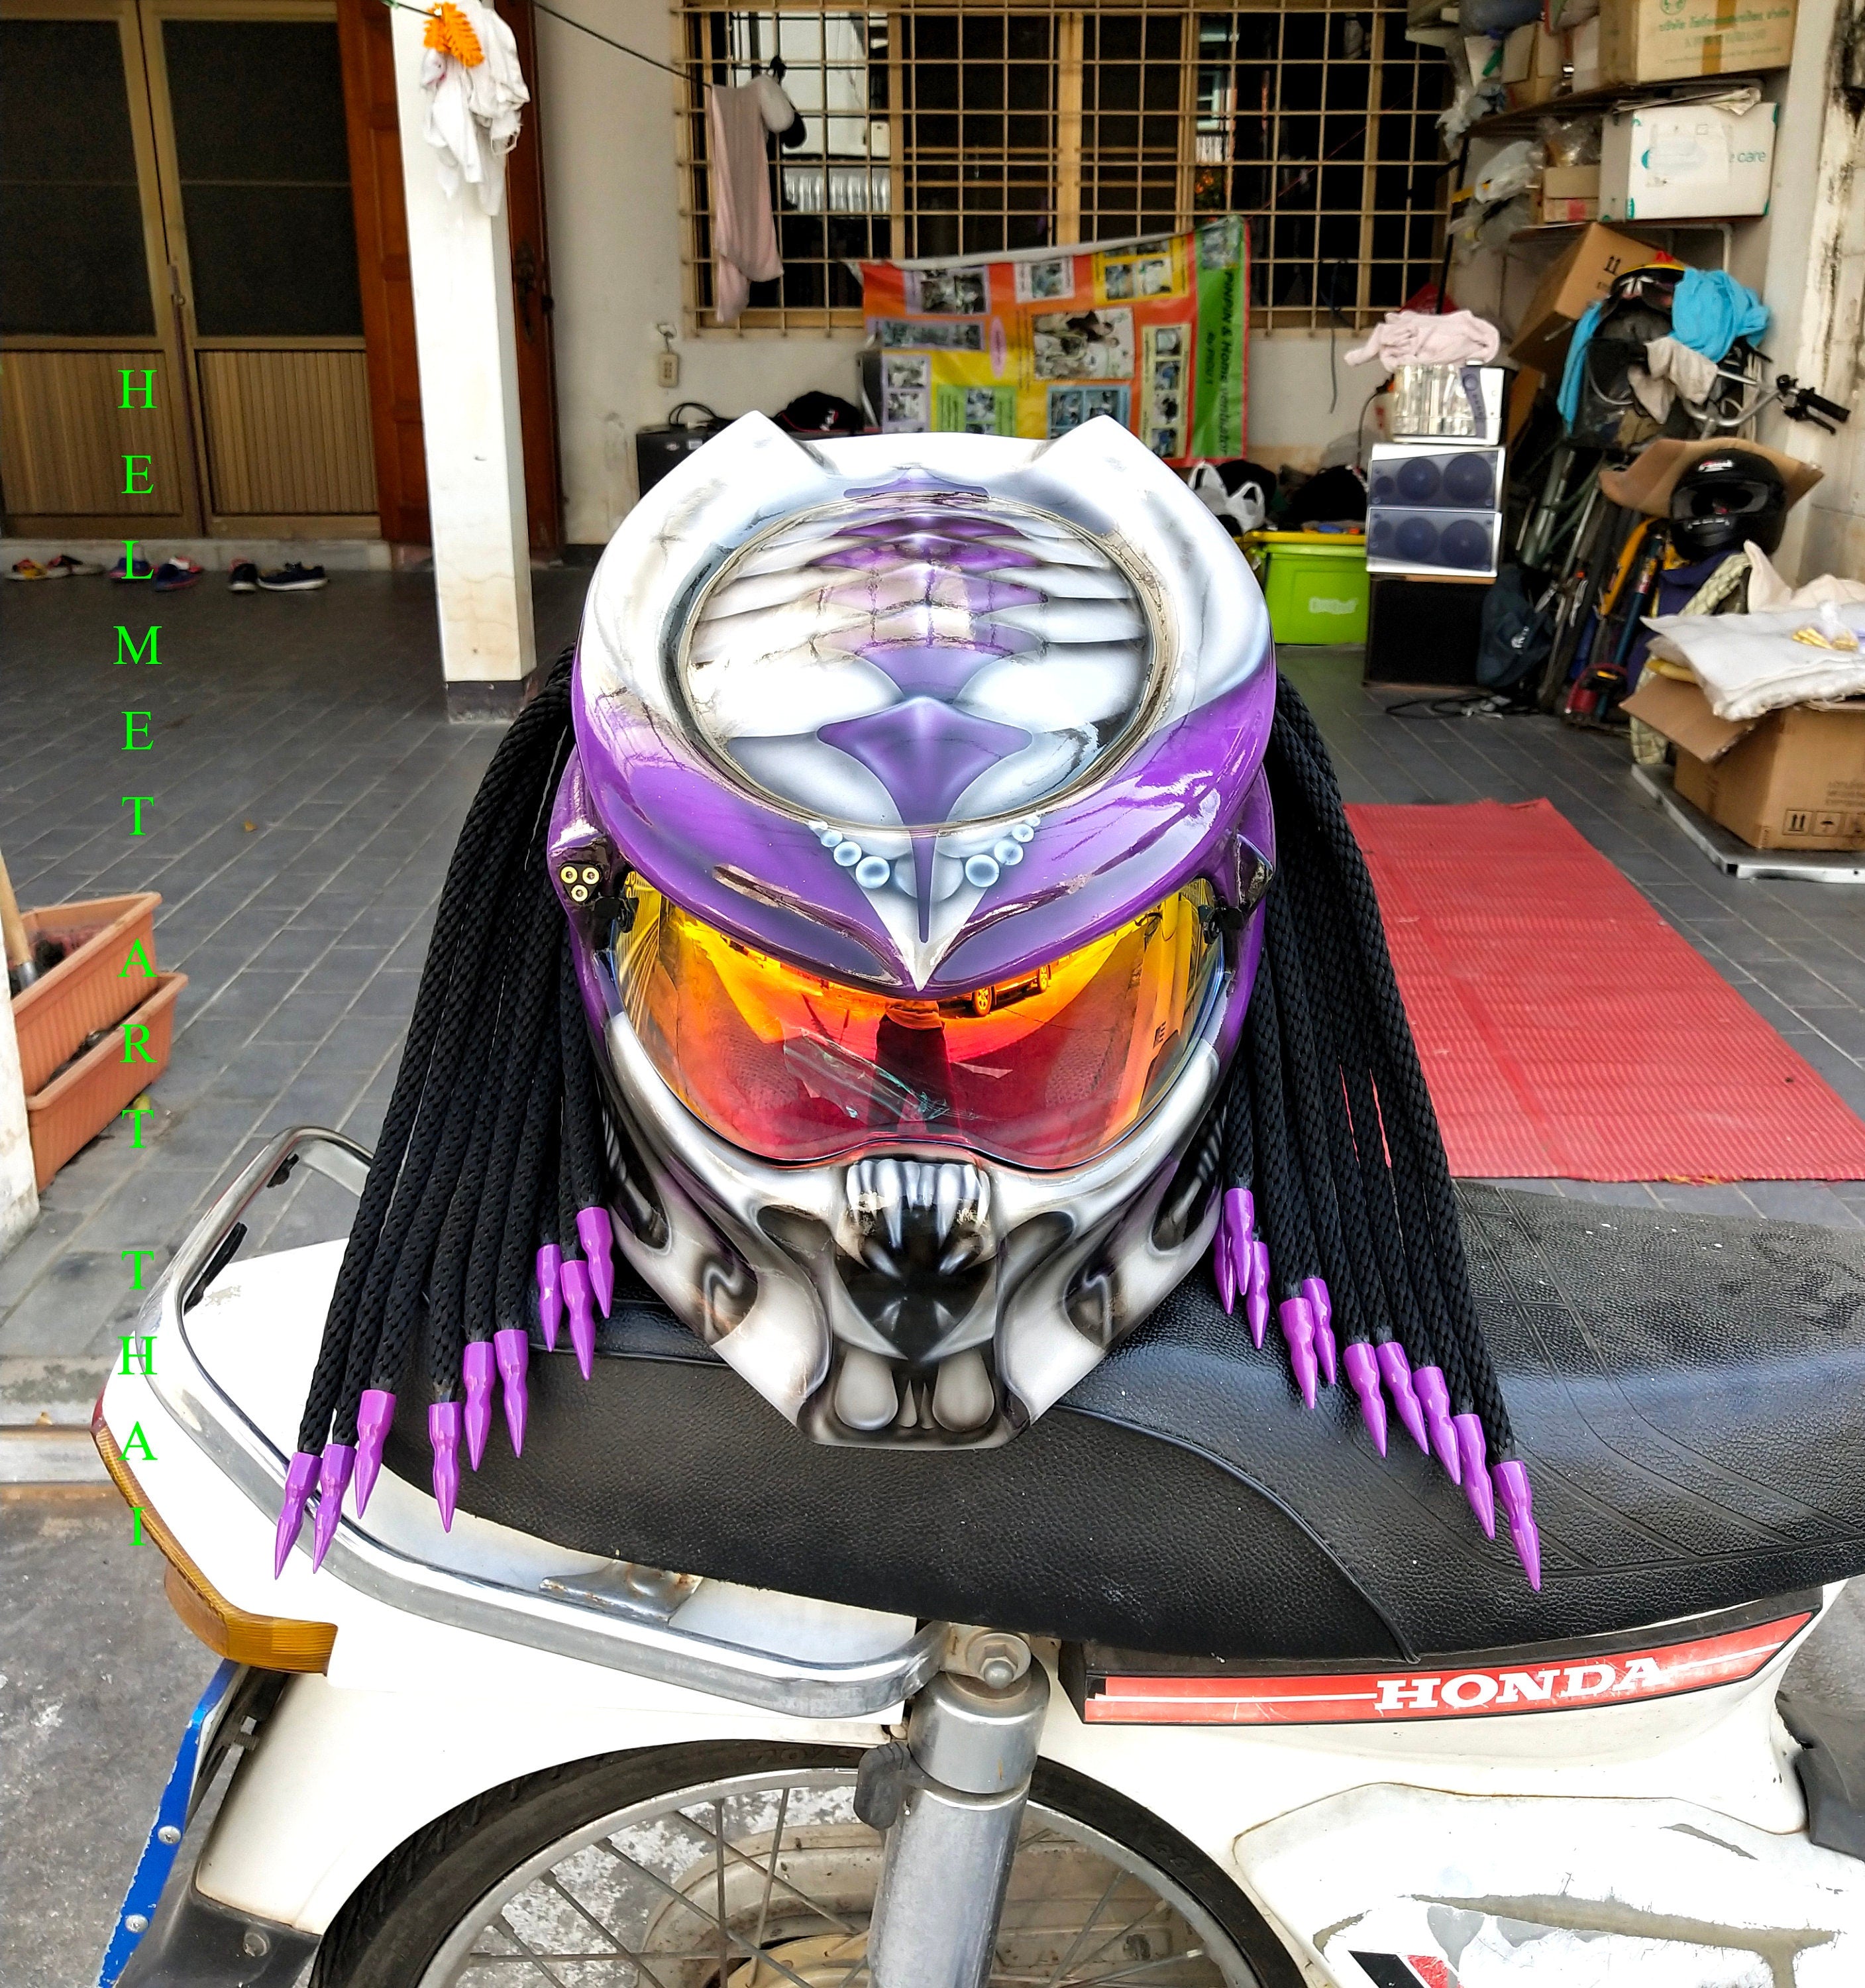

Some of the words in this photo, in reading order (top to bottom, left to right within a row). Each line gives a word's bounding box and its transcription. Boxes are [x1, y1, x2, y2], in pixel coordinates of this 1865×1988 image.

[1737, 150, 1766, 164] care
[1220, 341, 1232, 382] Home
[1375, 1657, 1670, 1710] HONDA
